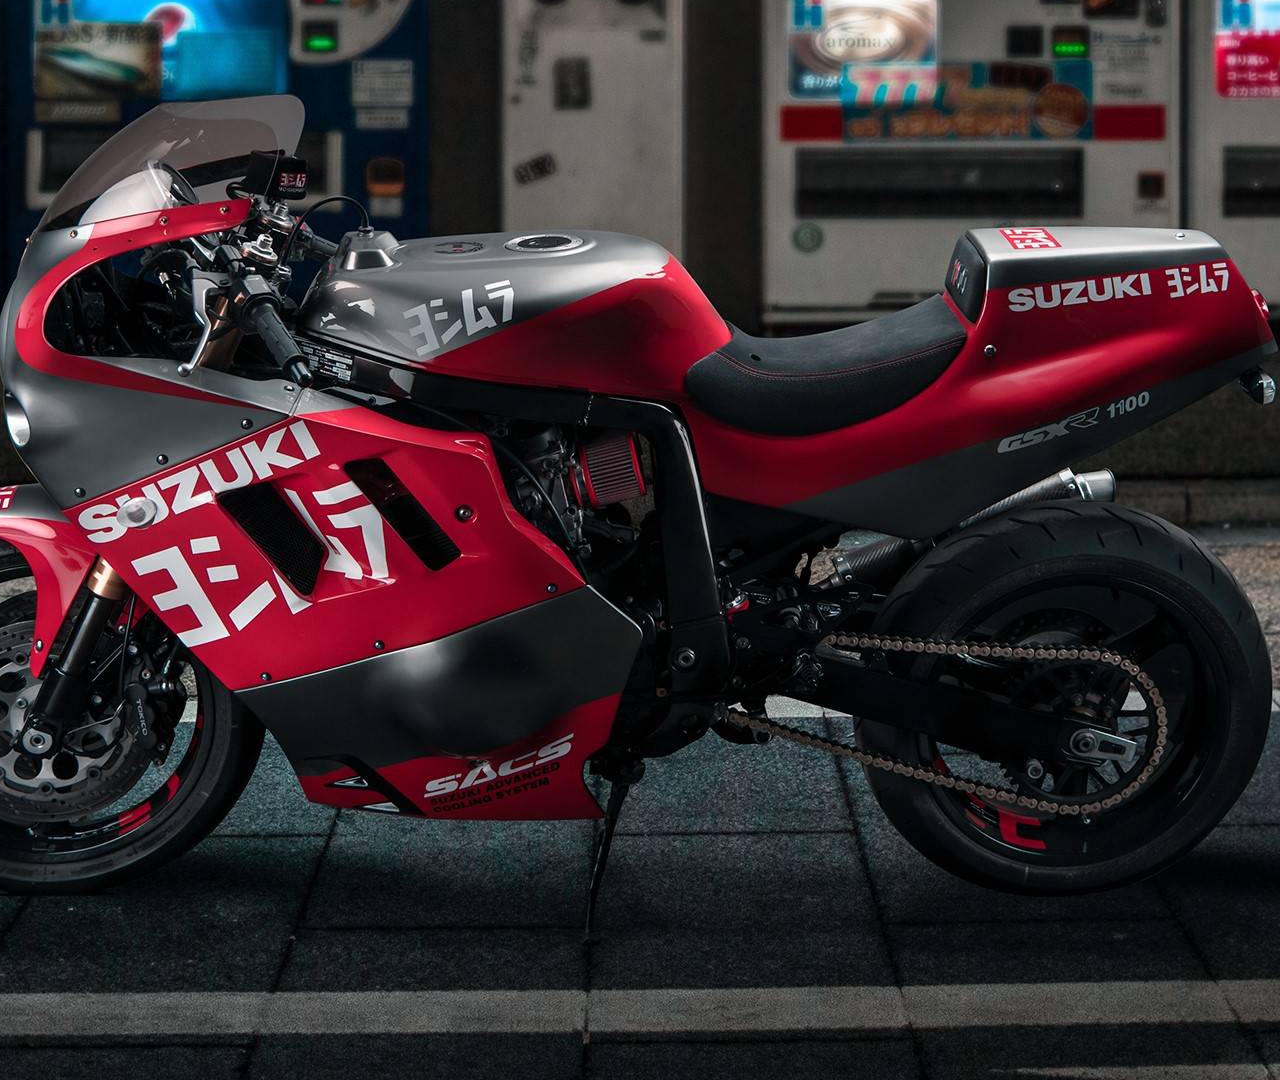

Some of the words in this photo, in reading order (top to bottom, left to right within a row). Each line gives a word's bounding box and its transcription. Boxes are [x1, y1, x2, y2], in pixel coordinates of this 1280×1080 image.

[826, 33, 895, 49] aromax
[1007, 273, 1152, 312] SUZUKI
[1165, 262, 1230, 299] ヨシムラ
[403, 280, 514, 357] ヨシムラ
[1107, 391, 1150, 419] 1100
[78, 420, 321, 543] SUZUKI
[136, 698, 148, 736] TOKICO
[424, 733, 574, 798] SACS
[430, 788, 481, 806] SUZUKI
[486, 761, 560, 793] ADVANCED
[433, 797, 492, 813] COOLING
[496, 777, 549, 800] SYSTEM
